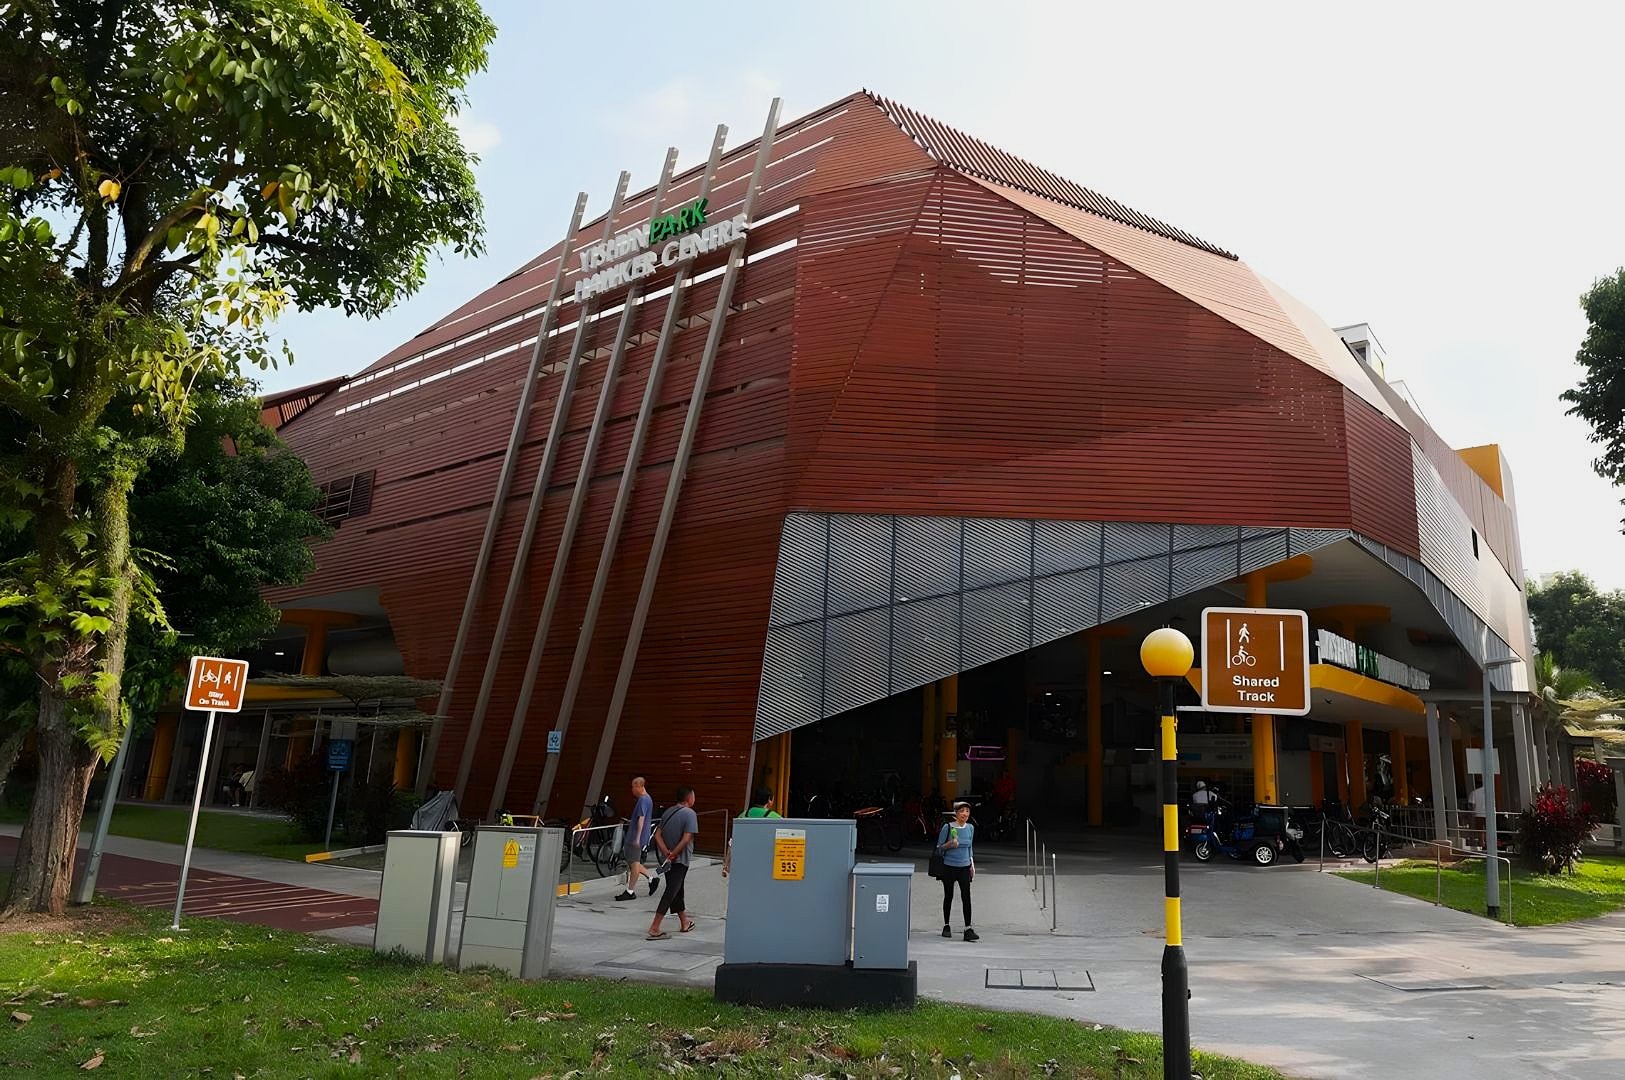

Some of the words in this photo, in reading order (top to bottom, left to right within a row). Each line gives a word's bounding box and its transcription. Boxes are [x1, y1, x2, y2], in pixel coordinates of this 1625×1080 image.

[650, 198, 708, 244] PARK
[574, 251, 657, 303] HAWKER
[661, 213, 749, 267] CENTRE
[1232, 675, 1280, 687] Shared
[1237, 690, 1275, 702] Track
